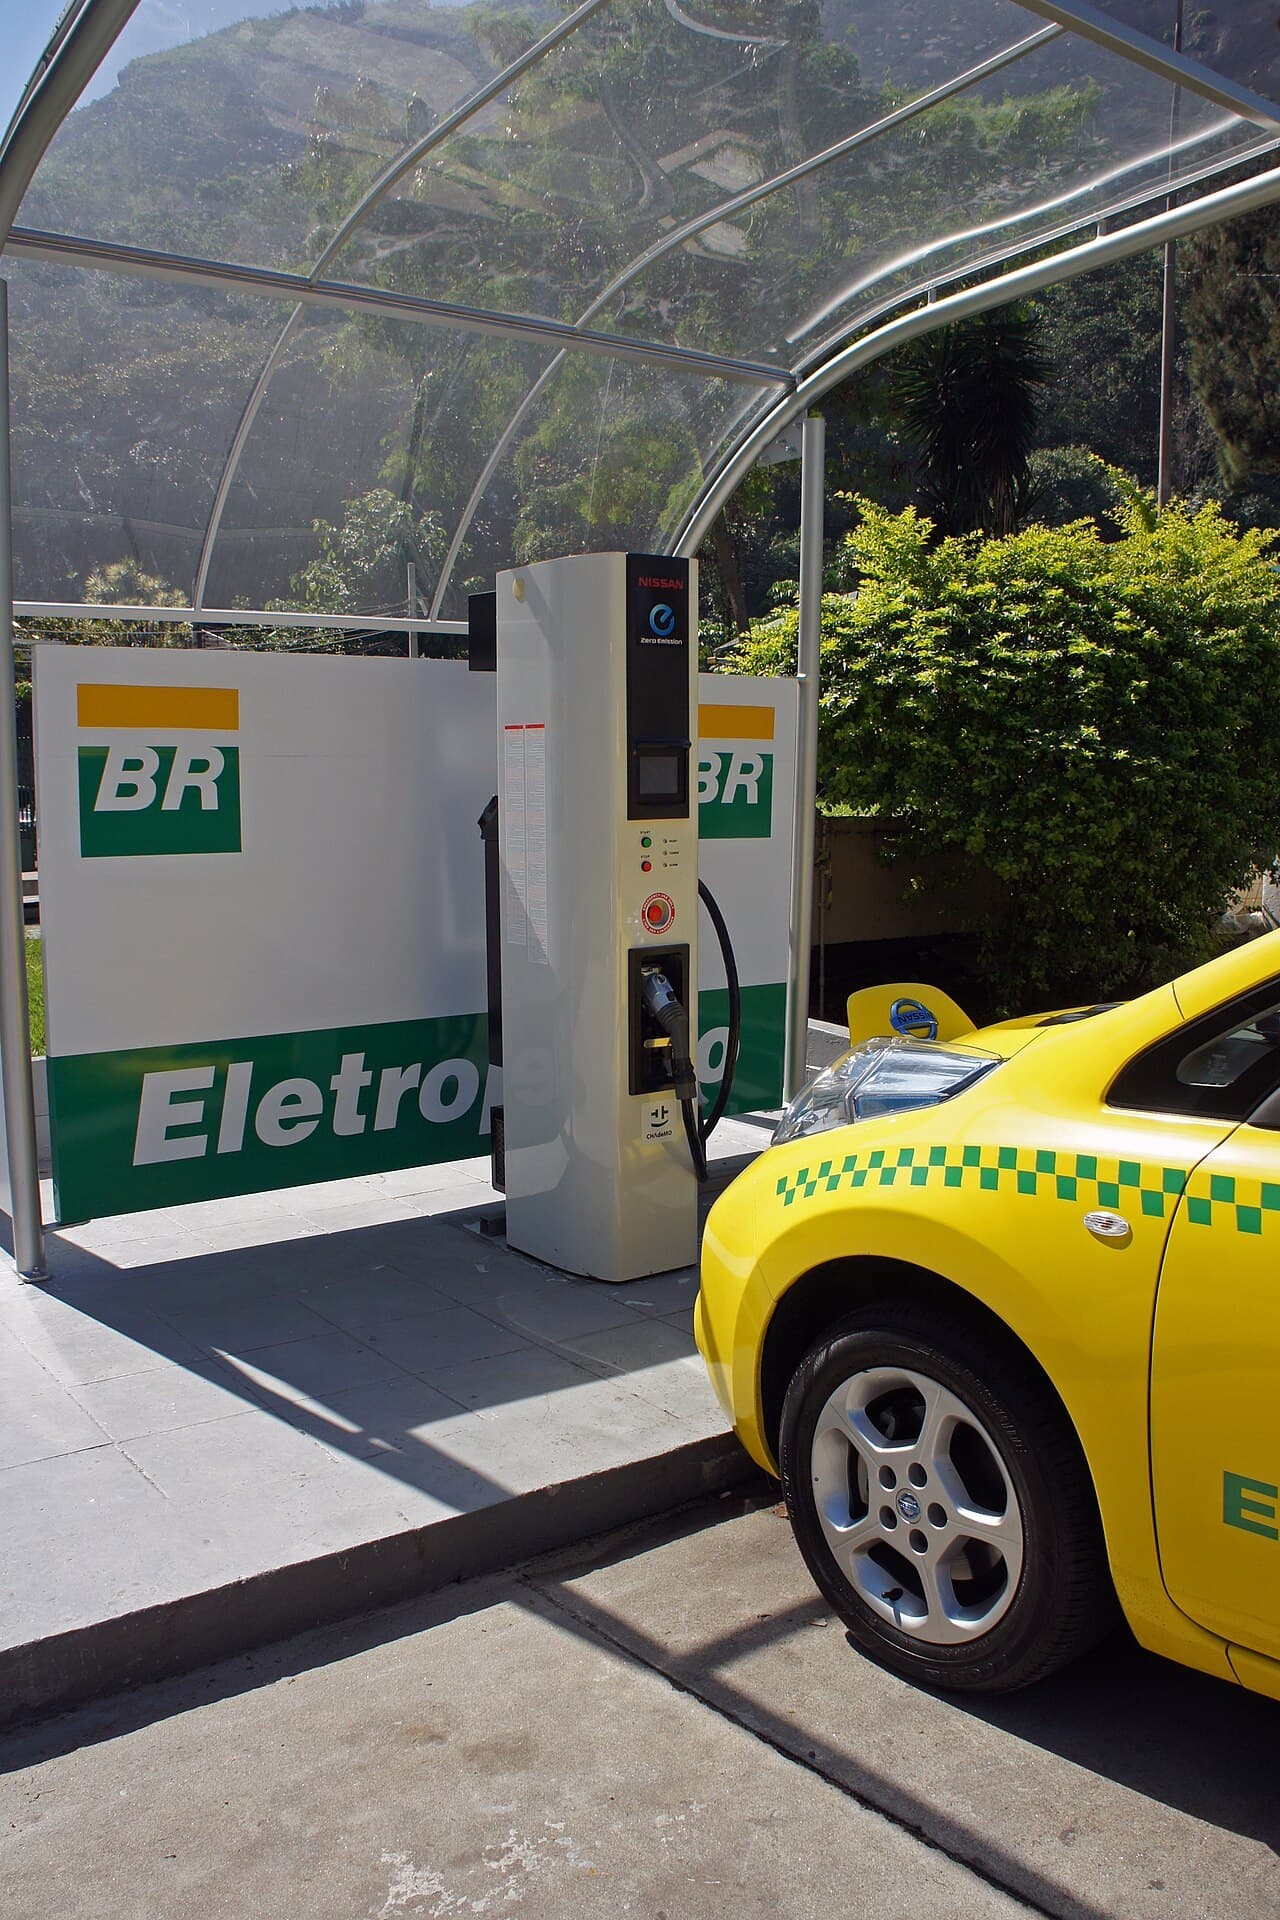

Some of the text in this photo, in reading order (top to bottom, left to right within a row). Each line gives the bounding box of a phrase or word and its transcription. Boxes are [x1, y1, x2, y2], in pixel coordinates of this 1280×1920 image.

[638, 576, 684, 590] NISSAN
[94, 745, 225, 812] BR
[1223, 1469, 1279, 1541] E
